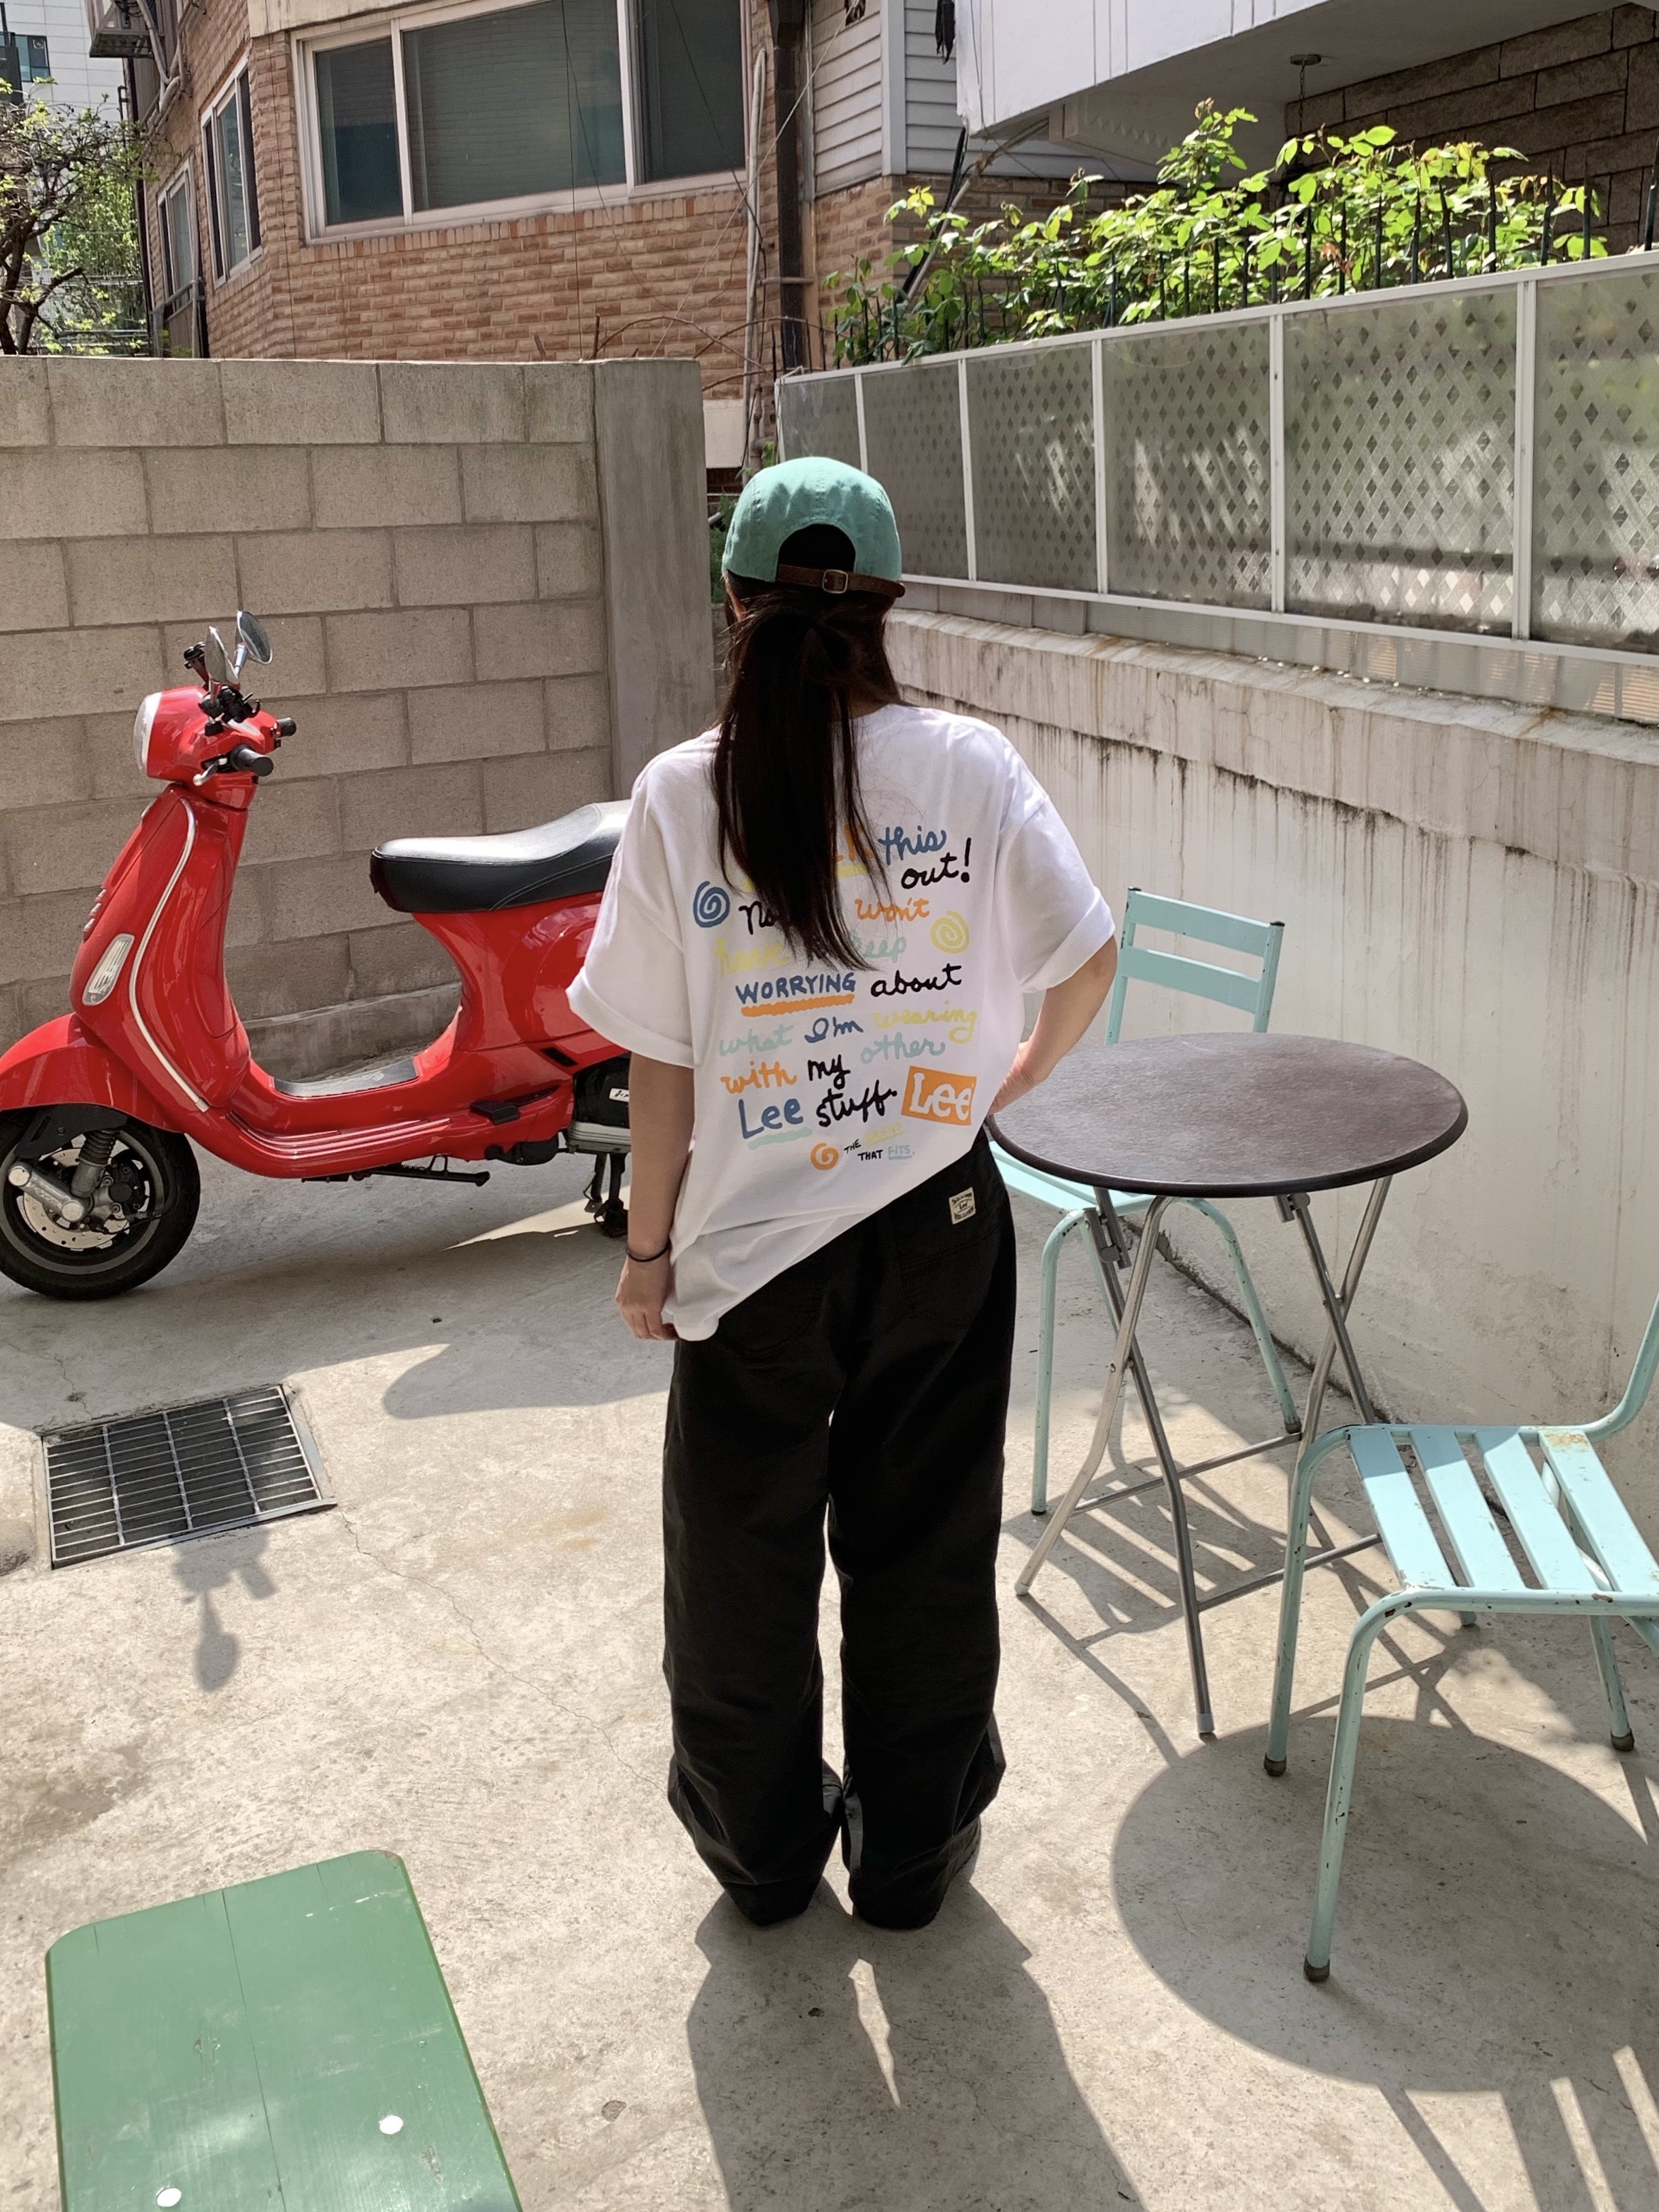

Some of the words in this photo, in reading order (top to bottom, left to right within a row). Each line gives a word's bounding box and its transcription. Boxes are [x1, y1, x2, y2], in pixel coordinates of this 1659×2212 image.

[878, 826, 947, 866] this
[901, 837, 972, 889] out!
[854, 897, 930, 922] won't
[735, 972, 856, 1004] WORRYING
[870, 963, 962, 998] about
[719, 1023, 795, 1056] what
[872, 1000, 976, 1044] wearing
[720, 1061, 798, 1094] with
[808, 1053, 851, 1090] my
[860, 1032, 946, 1065] other
[909, 1072, 972, 1121] Lee
[738, 1098, 804, 1140] Lee
[843, 1139, 861, 1155] THE
[857, 1149, 883, 1161] THAT
